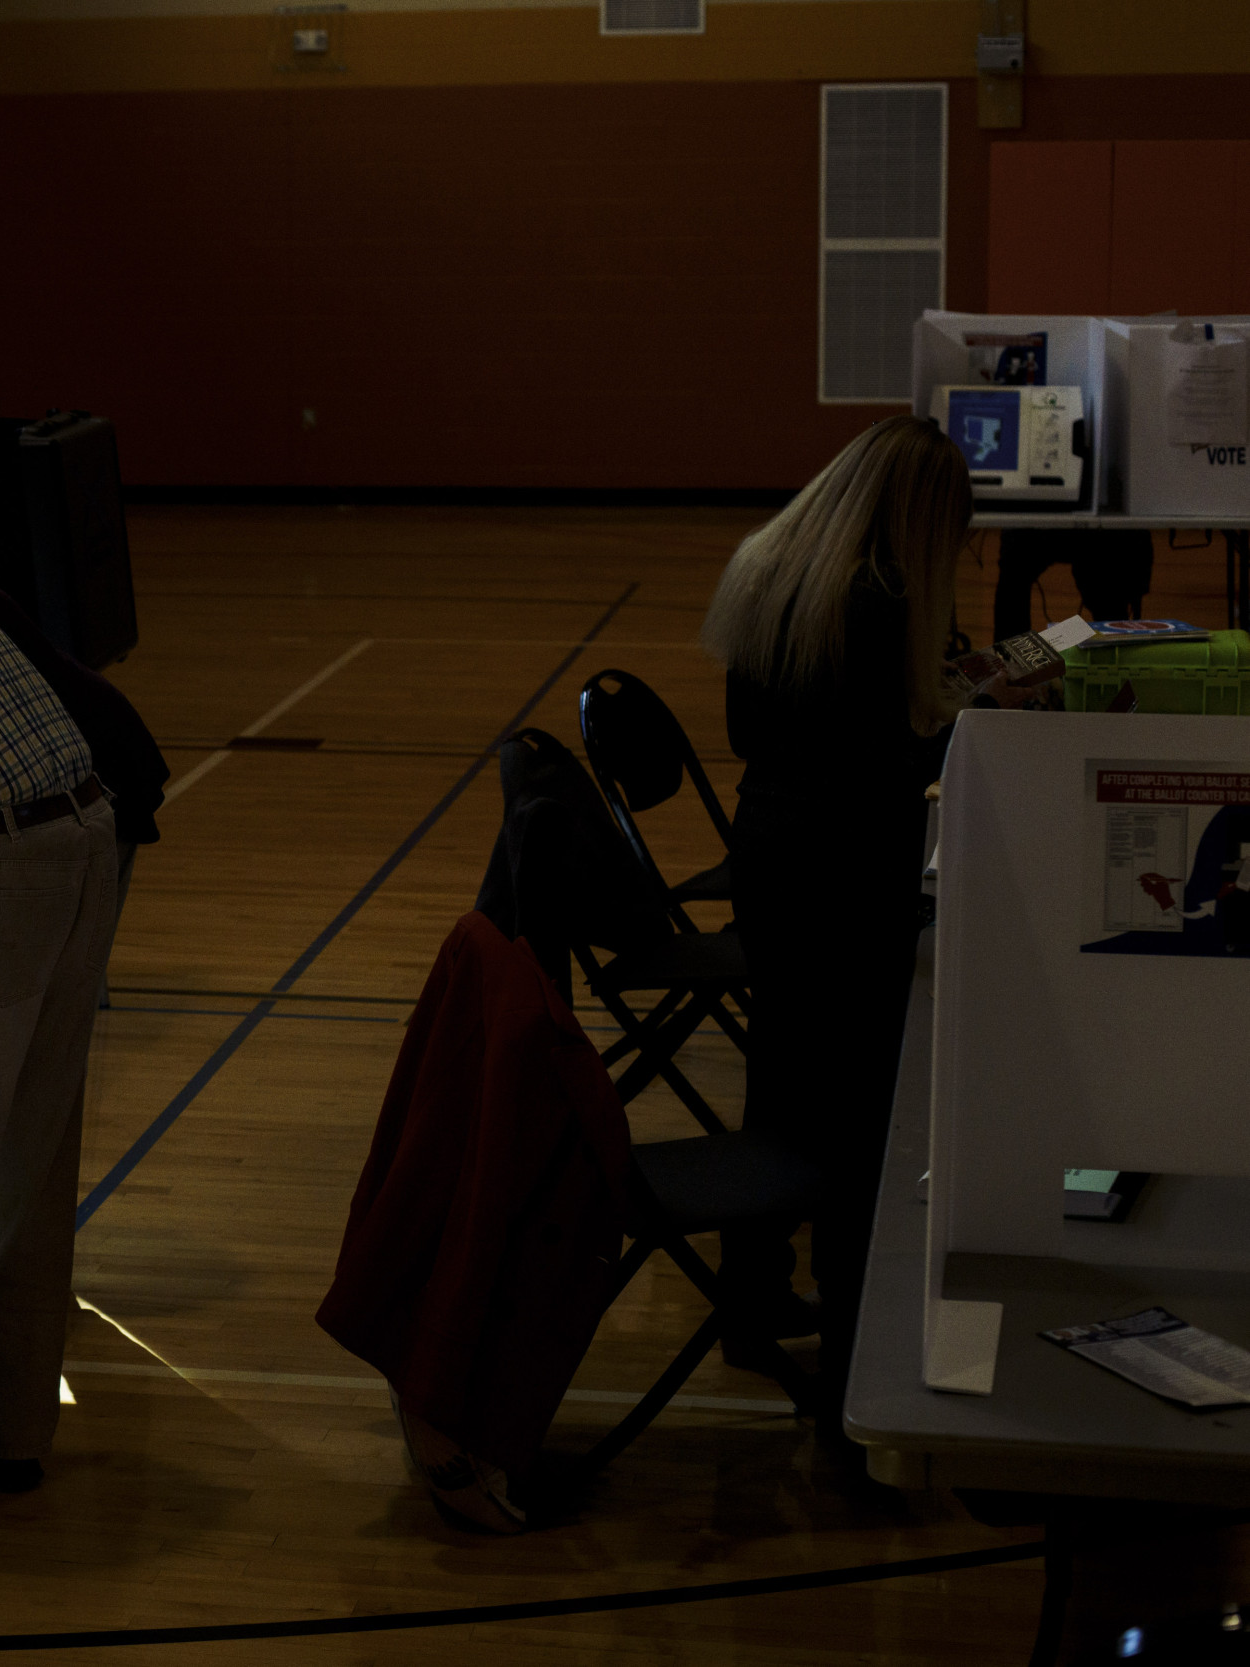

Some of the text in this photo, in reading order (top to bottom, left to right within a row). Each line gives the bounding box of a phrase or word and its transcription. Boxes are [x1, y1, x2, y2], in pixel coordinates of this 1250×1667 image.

[1207, 446, 1246, 465] VOTE
[1102, 774, 1128, 785] AFTER
[1130, 774, 1182, 786] COMPLETING
[1183, 775, 1204, 787] YOUR
[1124, 788, 1135, 799] AT
[1137, 788, 1153, 800] THE
[1154, 789, 1185, 801] BALLOT
[1186, 790, 1225, 802] COUNTER
[1227, 791, 1237, 802] TO
